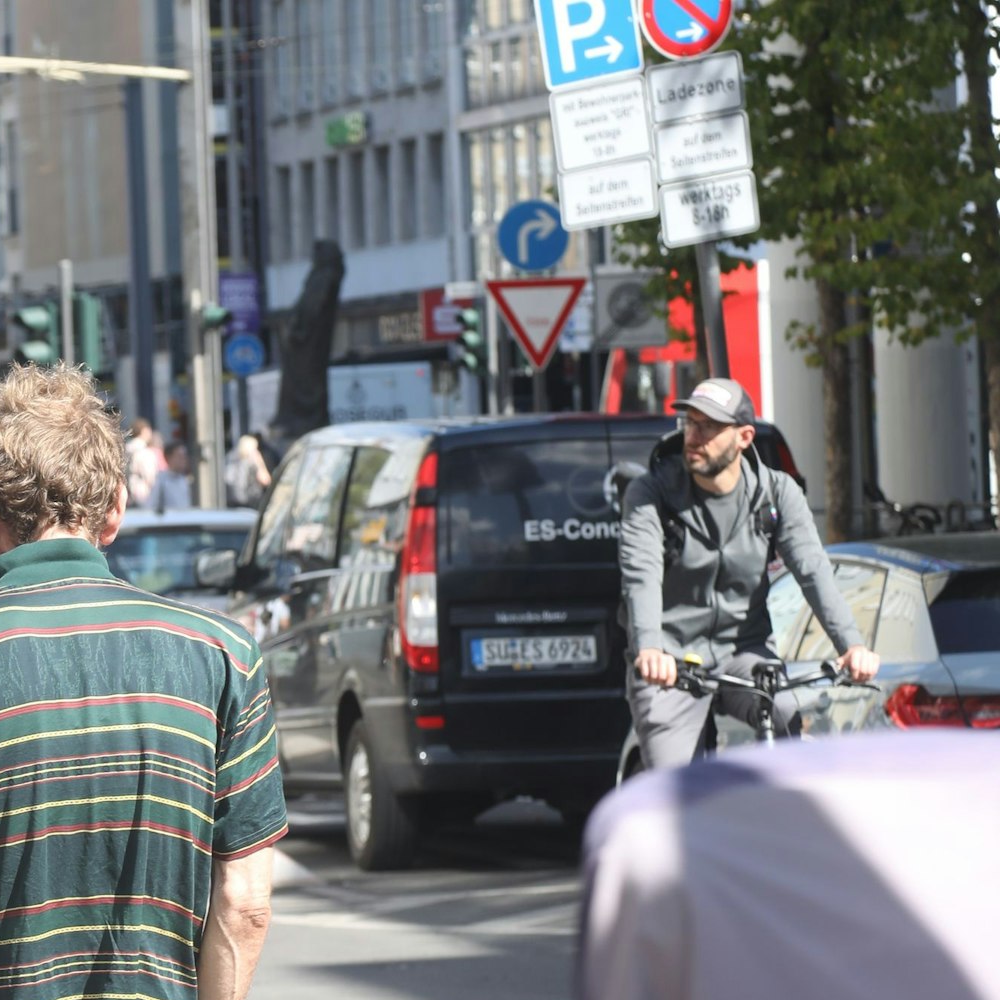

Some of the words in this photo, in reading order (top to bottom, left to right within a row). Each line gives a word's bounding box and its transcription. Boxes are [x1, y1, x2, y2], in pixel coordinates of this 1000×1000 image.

[552, 0, 606, 73] P
[656, 78, 736, 104] Ladezone
[680, 182, 741, 206] werktags
[548, 636, 592, 659] 6924
